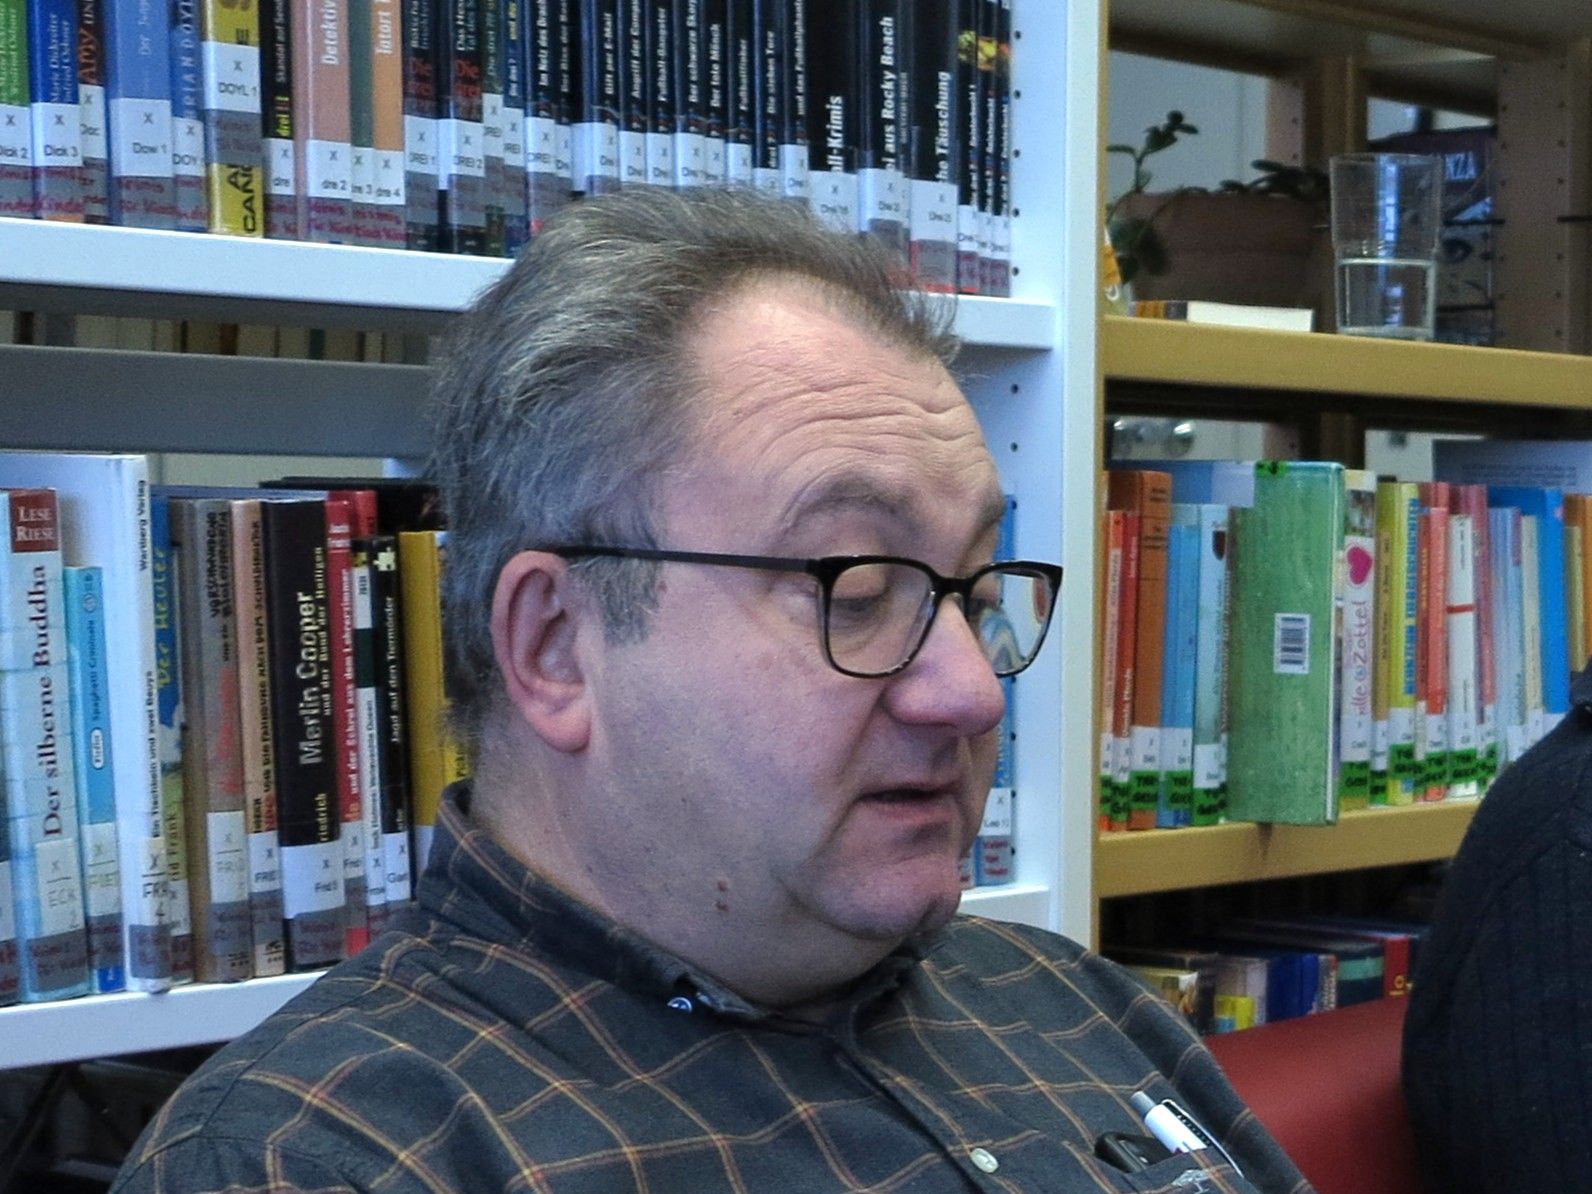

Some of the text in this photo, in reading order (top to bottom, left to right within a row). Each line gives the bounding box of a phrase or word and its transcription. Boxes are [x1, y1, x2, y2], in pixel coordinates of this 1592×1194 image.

[878, 16, 894, 67] Beach
[880, 71, 897, 120] Rocky
[934, 71, 951, 156] Täuschung
[16, 526, 56, 542] RIESE
[18, 505, 51, 522] LESE
[313, 546, 332, 716] und der Bund der Heiligen
[343, 655, 354, 680] dem
[384, 596, 400, 743] Jagd auf den Tiermörder
[27, 564, 63, 838] Der silberne Buddha
[296, 590, 330, 842] riedrich Merlin Cooper
[348, 773, 358, 795] und
